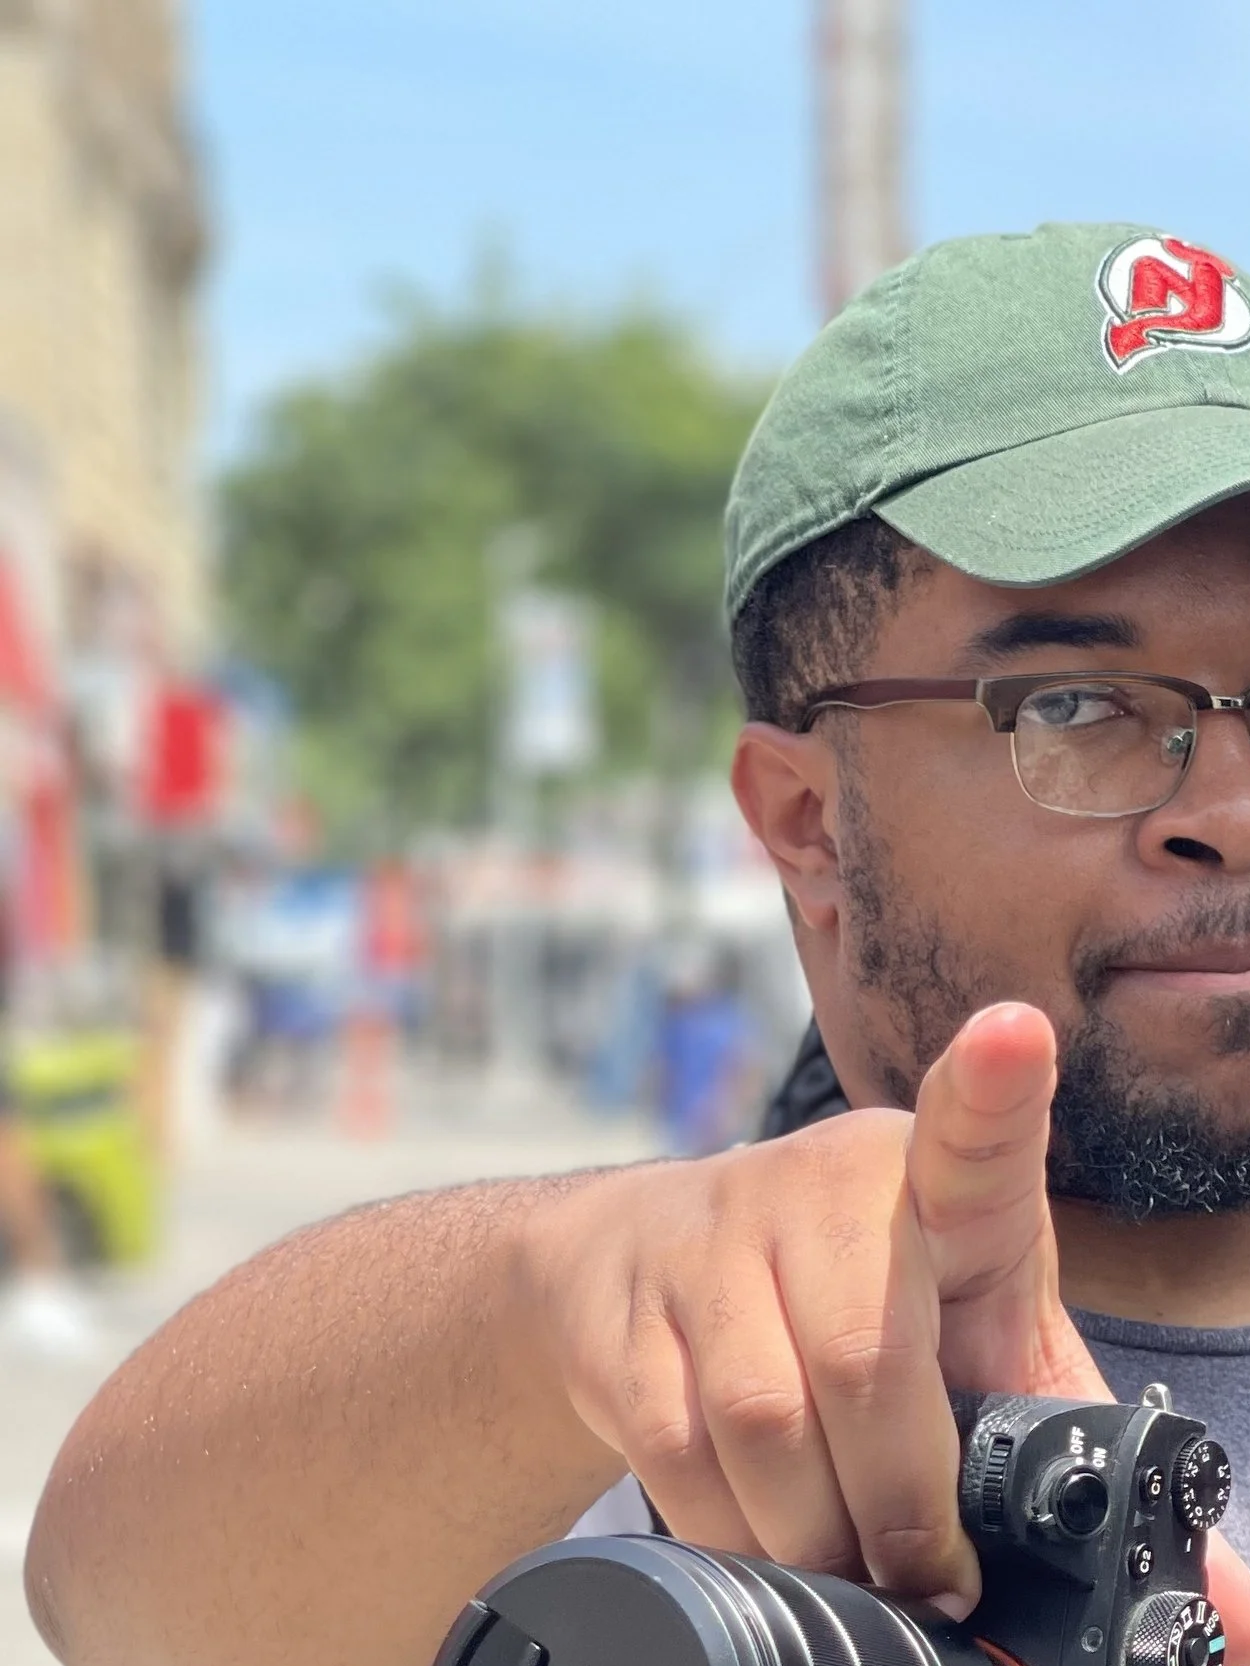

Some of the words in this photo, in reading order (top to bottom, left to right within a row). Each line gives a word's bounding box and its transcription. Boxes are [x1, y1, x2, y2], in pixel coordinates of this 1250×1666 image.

[1070, 1426, 1085, 1454] OFF
[1093, 1447, 1108, 1468] ON
[1151, 1475, 1162, 1495] C1
[1140, 1551, 1152, 1574] C2
[1203, 1610, 1220, 1637] SCN
[1172, 1627, 1183, 1646] 2
